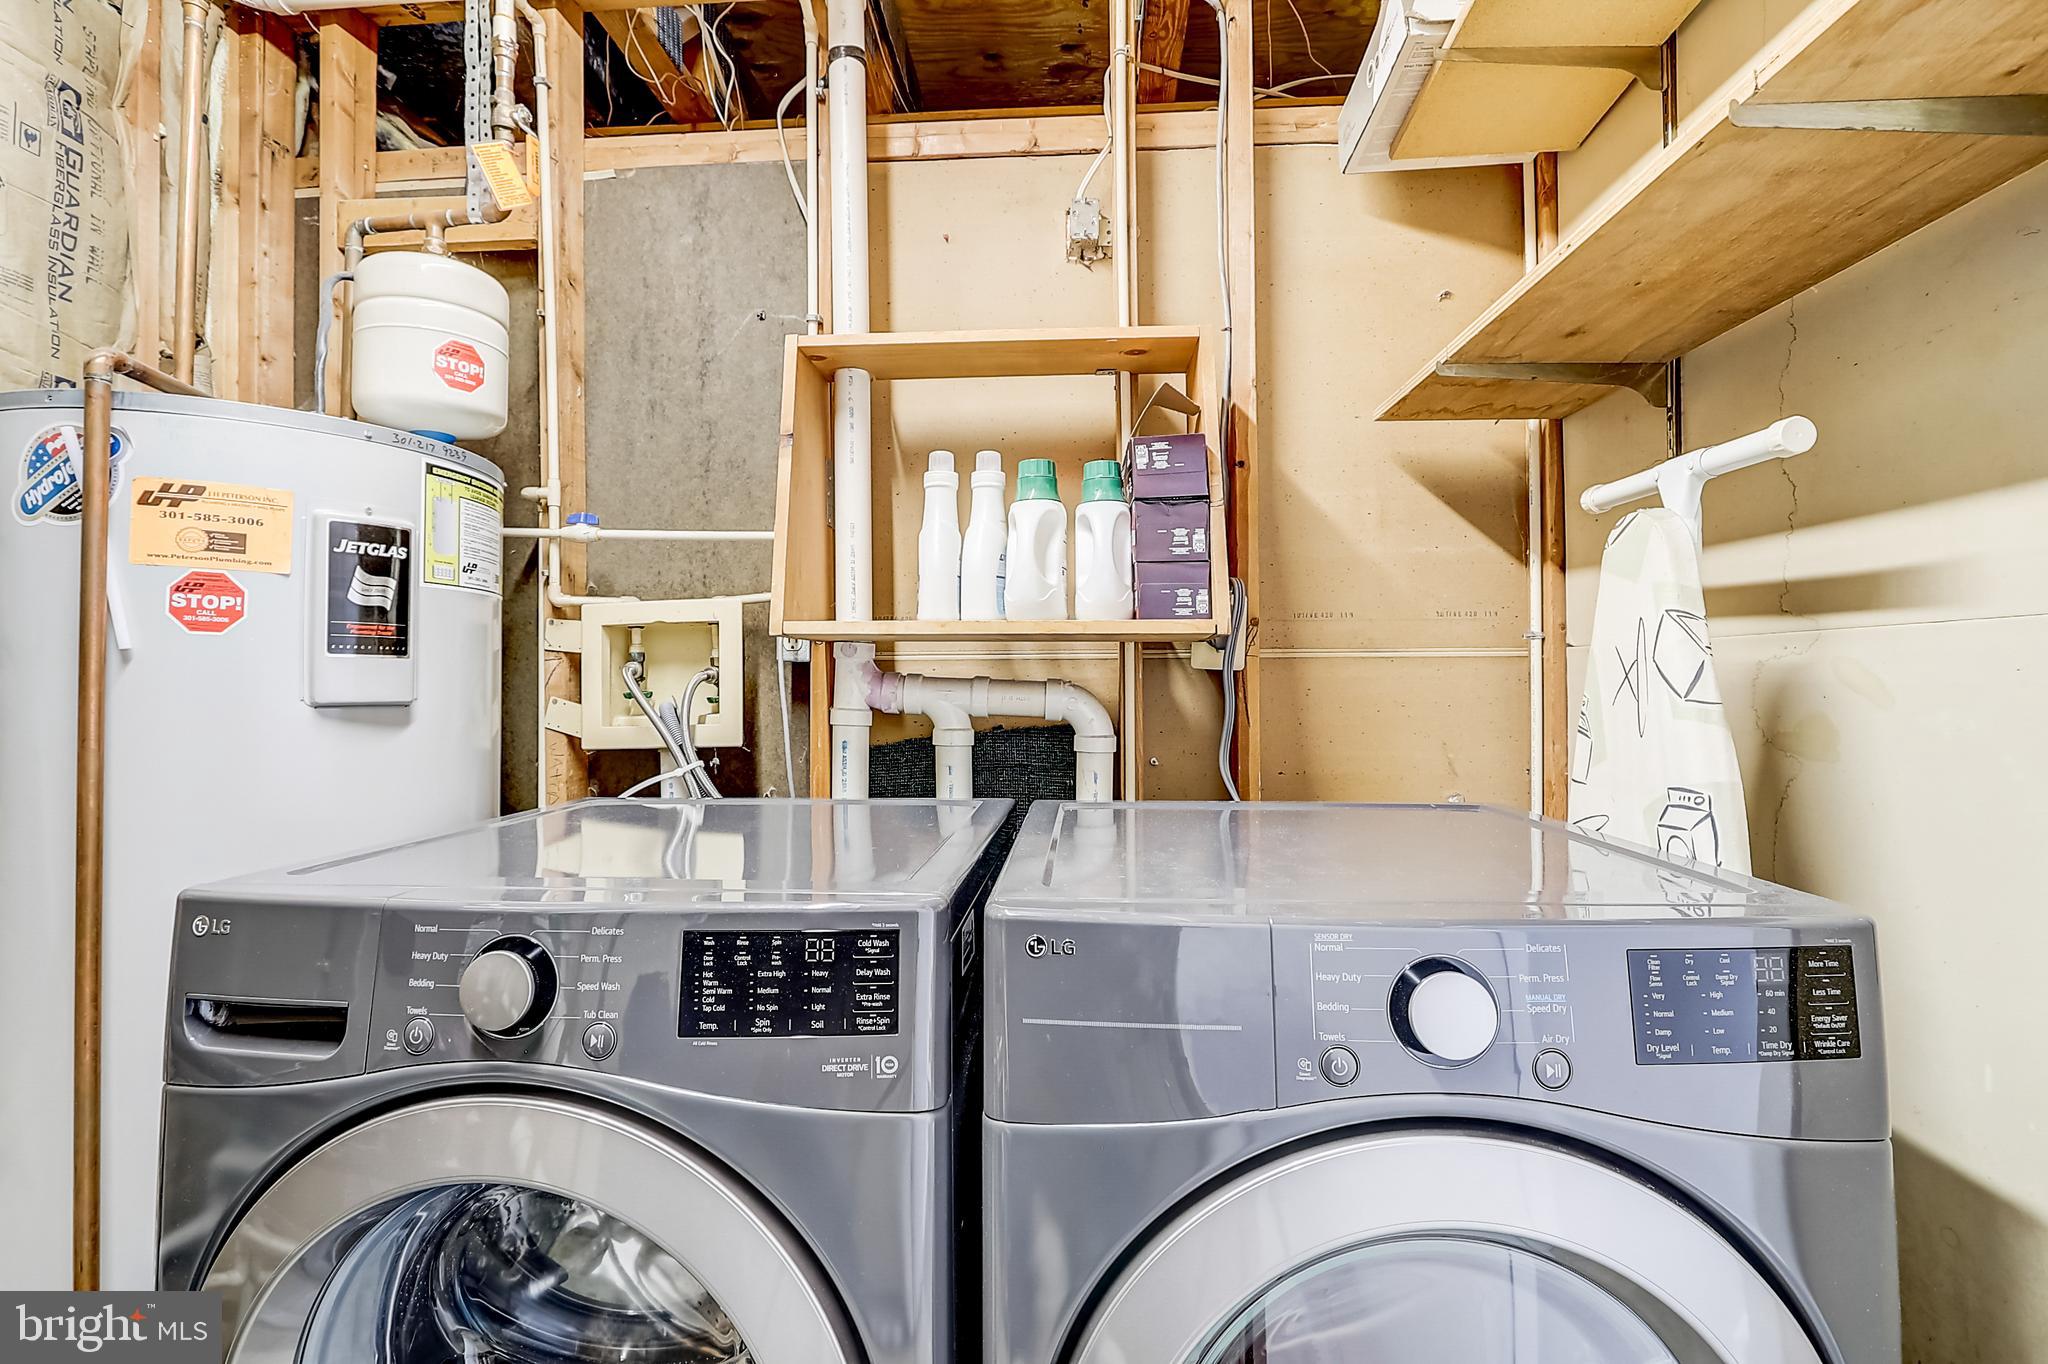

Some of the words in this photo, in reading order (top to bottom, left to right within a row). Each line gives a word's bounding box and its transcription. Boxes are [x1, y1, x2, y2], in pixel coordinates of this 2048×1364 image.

[48, 140, 66, 251] FIBERGLASS
[58, 146, 84, 303] GUARDIAN
[47, 255, 61, 360] INSULATION
[435, 354, 484, 378] STOP!
[159, 510, 264, 526] 301-585-3006
[333, 539, 408, 560] JETGLAS
[147, 552, 272, 566] www.PetersonPlumbing.com
[171, 593, 242, 610] STOP!
[212, 919, 232, 934] LG
[415, 924, 438, 933] Normal
[592, 926, 624, 935] Delicates
[1051, 938, 1076, 956] LG
[1314, 943, 1343, 952] Normal
[1525, 944, 1561, 952] Delicates
[411, 951, 431, 960] Heavy
[432, 952, 448, 962] Duty
[856, 969, 873, 977] Delay
[1315, 972, 1341, 983] Heavy
[1343, 973, 1361, 984] Duty
[408, 979, 435, 988] Bedding
[1542, 974, 1564, 983] Press
[577, 982, 598, 992] Speed
[600, 982, 620, 991] Wash
[1710, 991, 1724, 1000] High
[407, 1006, 427, 1015] Towels
[811, 1003, 826, 1011] Light
[1317, 1003, 1350, 1013] Bedding
[1527, 1004, 1551, 1015] Speed
[1552, 1004, 1567, 1015] Dry
[598, 1011, 618, 1019] Clean
[1811, 1015, 1831, 1024] Energy
[699, 1022, 718, 1031] Temp.
[755, 1018, 770, 1027] Spin
[811, 1020, 824, 1028] Soil
[1319, 1032, 1346, 1042] Towels
[1655, 1029, 1672, 1037] Damp
[1542, 1035, 1553, 1043] Air
[1555, 1035, 1570, 1046] Dry
[1646, 1044, 1659, 1053] Dry
[1661, 1043, 1680, 1052] Level
[1712, 1046, 1732, 1056] Temp.
[1780, 1042, 1792, 1050] Dry
[875, 1056, 898, 1074] 10
